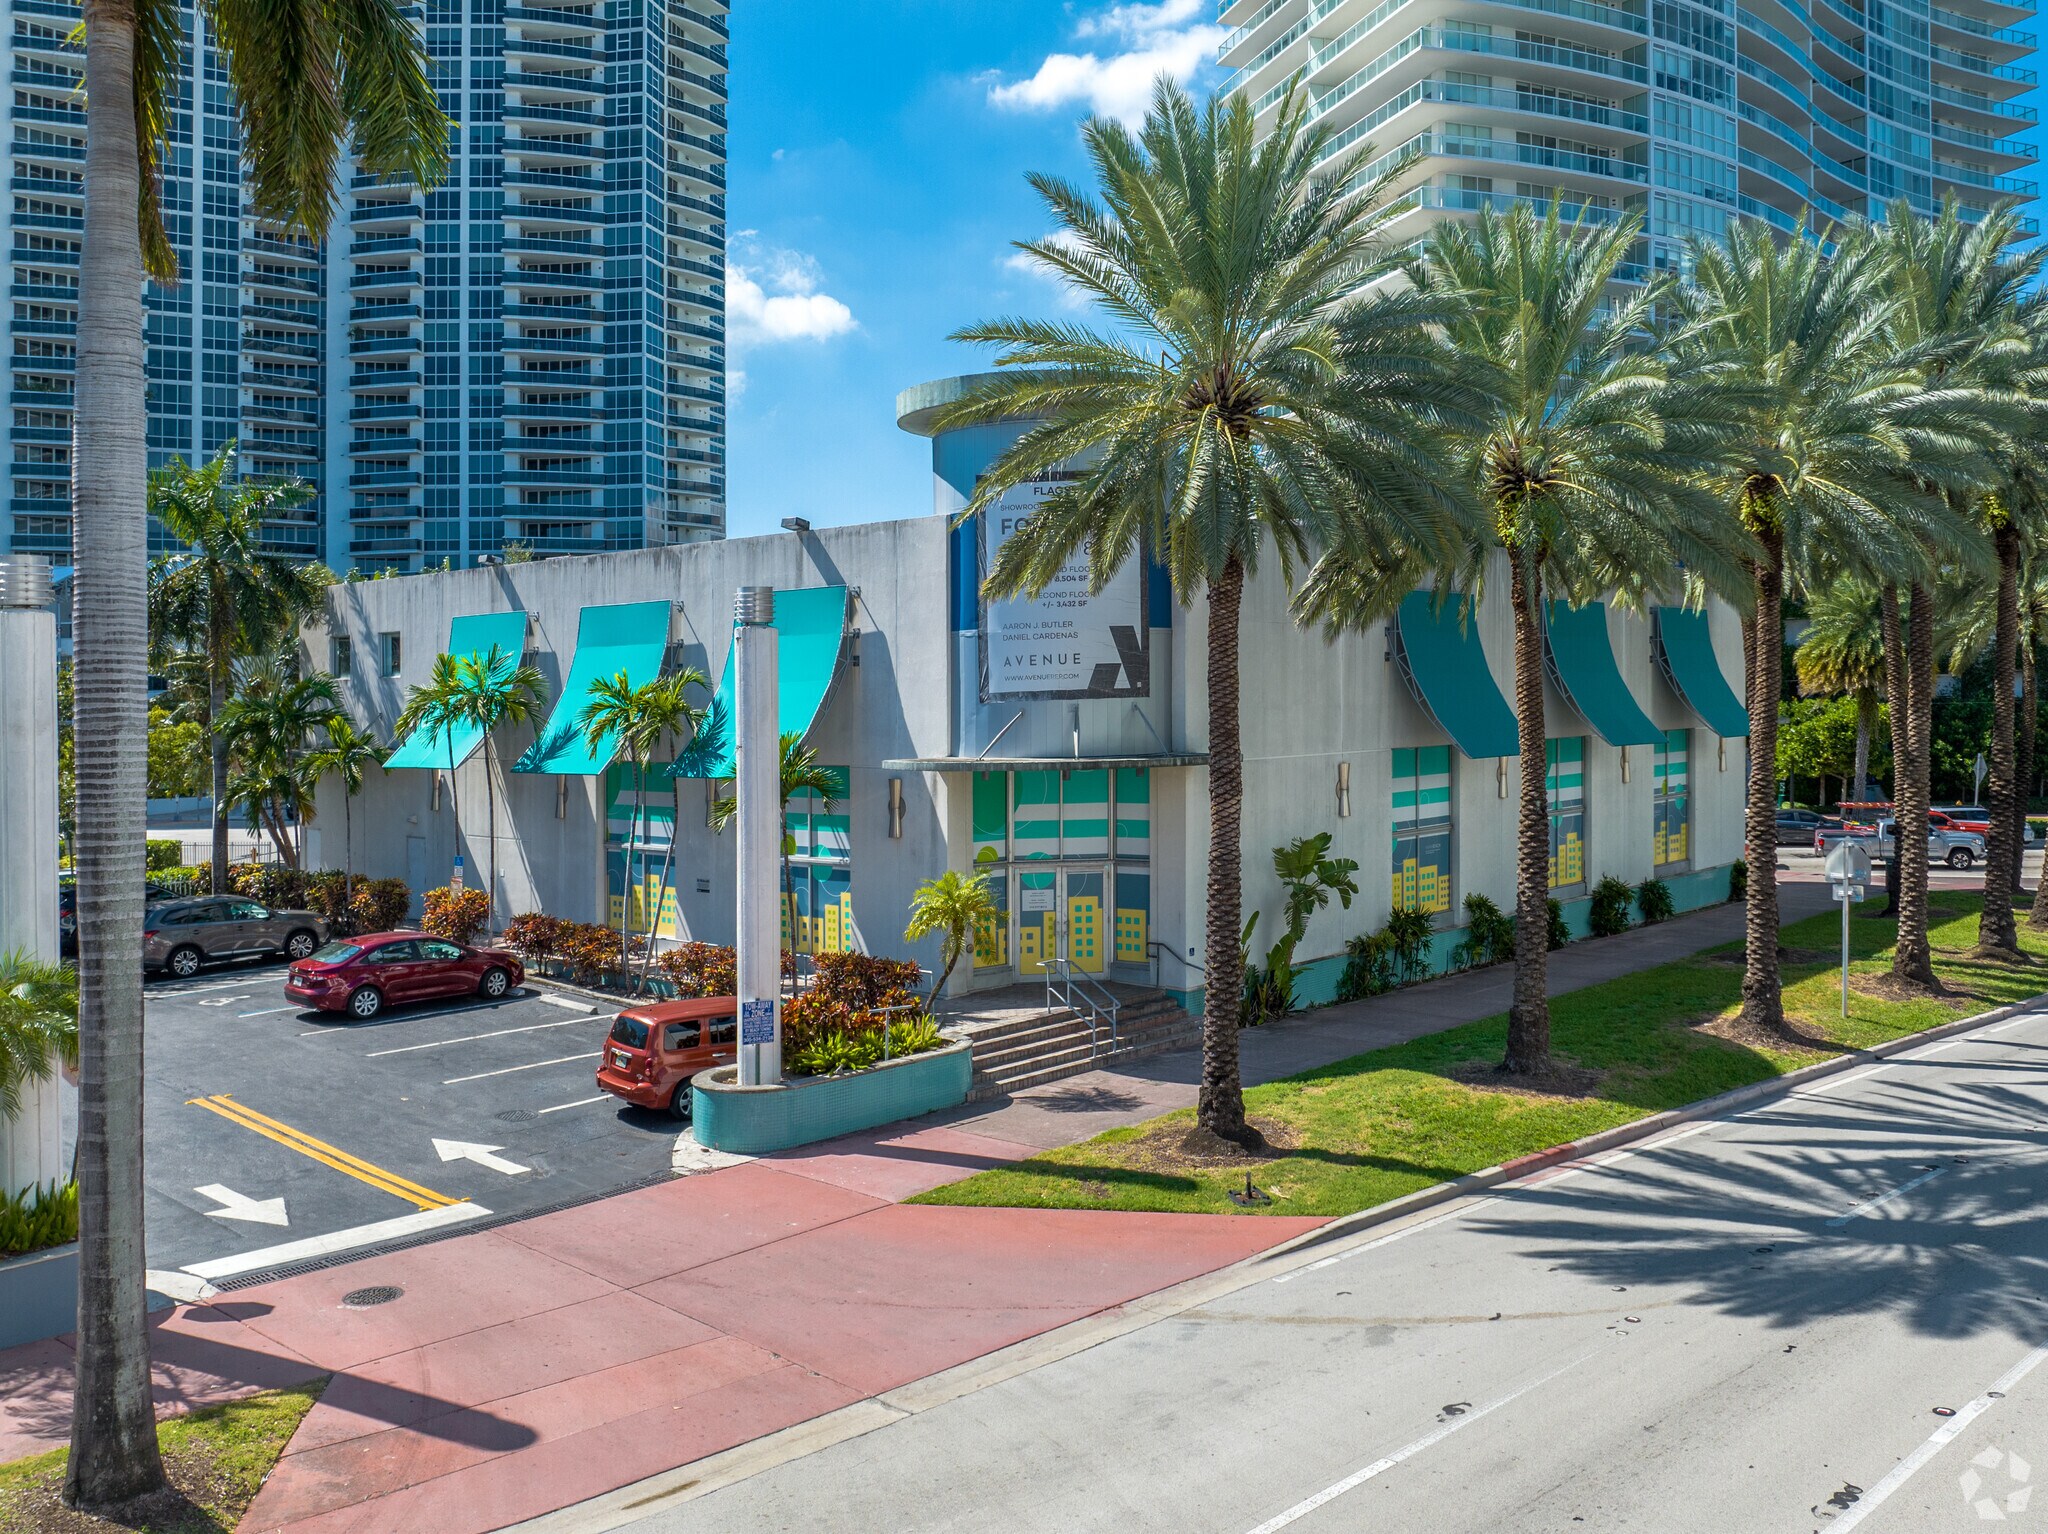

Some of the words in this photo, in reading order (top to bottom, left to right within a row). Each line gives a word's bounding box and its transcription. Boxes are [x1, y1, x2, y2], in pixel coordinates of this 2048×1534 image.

[1000, 503, 1041, 512] SHOWROO
[1038, 591, 1068, 599] ECOND
[1041, 601, 1054, 609] +/-
[1002, 622, 1032, 630] AARON
[1033, 622, 1040, 630] J.
[1041, 621, 1074, 629] BUTLER
[1002, 634, 1031, 642] DANIEL
[1032, 631, 1079, 640] CARDENAS
[1003, 652, 1082, 668] AVENUE
